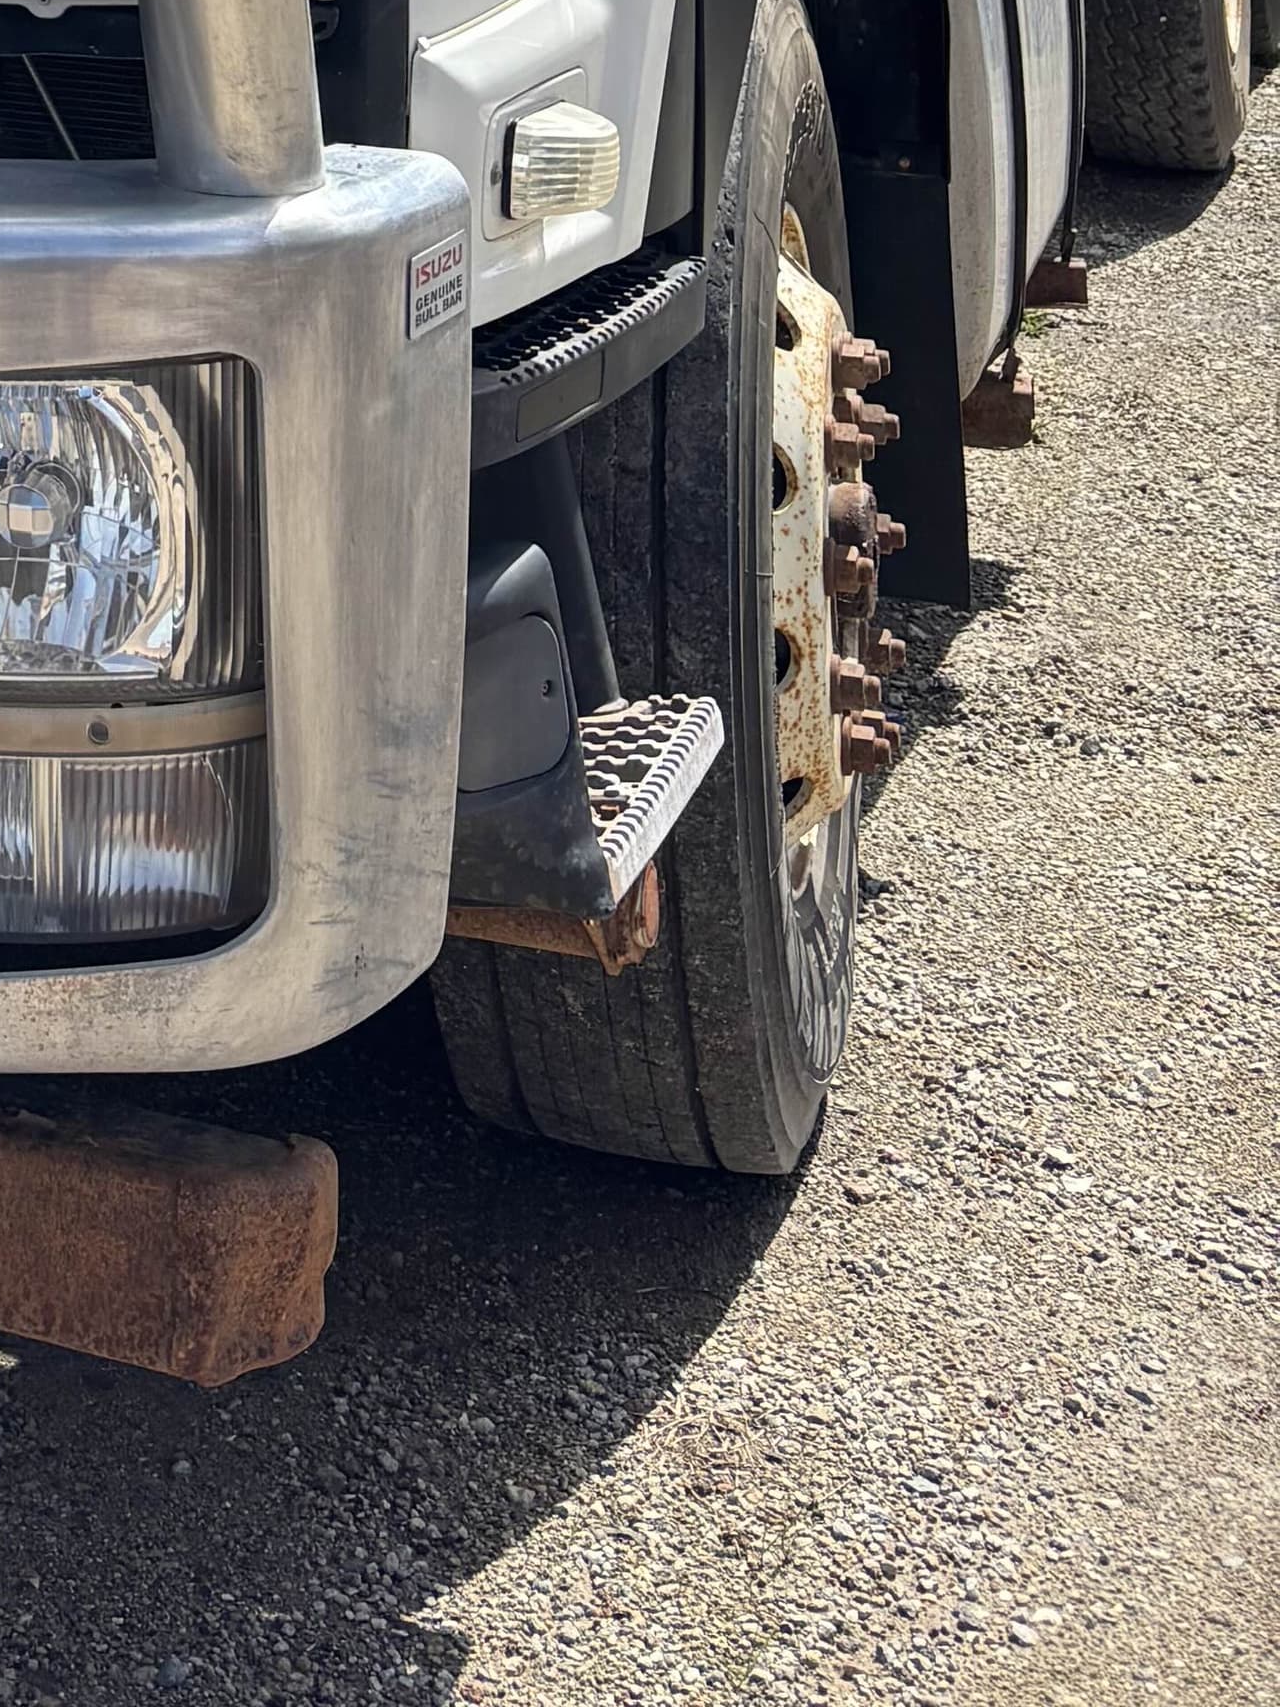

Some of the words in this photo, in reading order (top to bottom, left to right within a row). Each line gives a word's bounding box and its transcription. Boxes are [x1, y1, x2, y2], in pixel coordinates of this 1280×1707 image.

[415, 242, 463, 289] ISUZU
[415, 273, 463, 312] GENUINE
[415, 303, 441, 327] BULL
[442, 289, 462, 312] BAR
